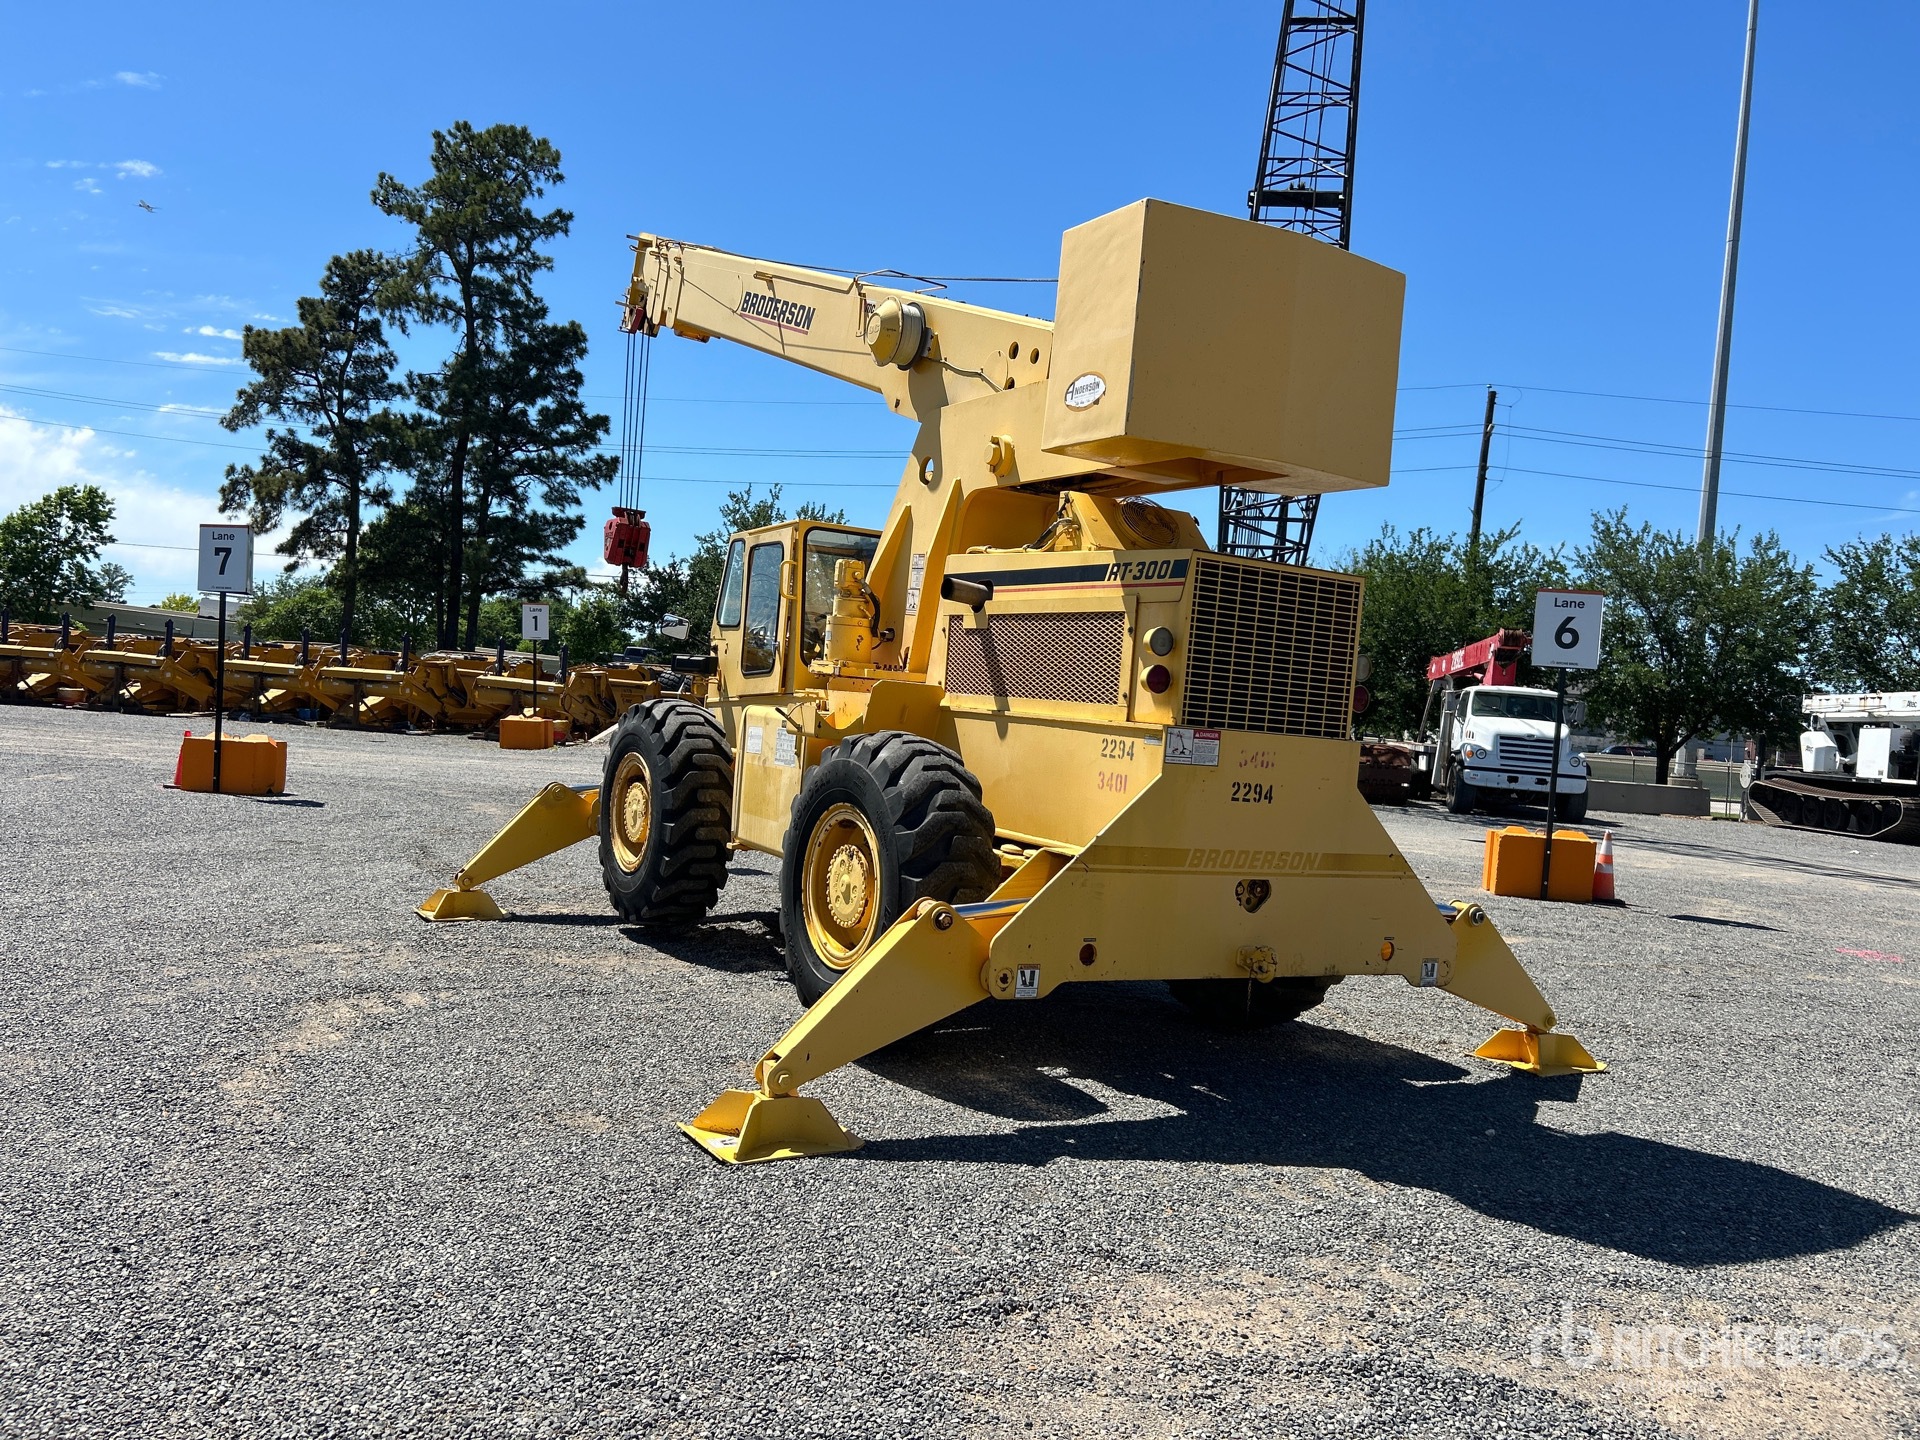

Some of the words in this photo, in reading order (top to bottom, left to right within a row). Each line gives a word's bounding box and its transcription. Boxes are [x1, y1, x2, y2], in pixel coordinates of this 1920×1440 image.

[741, 291, 816, 330] BRODERSON
[1065, 381, 1101, 401] ANDERSON
[212, 531, 235, 541] Lane
[214, 547, 232, 575] 7
[1106, 559, 1172, 581] RT-300
[1554, 597, 1586, 609] Lane
[532, 615, 538, 631] 1
[1554, 615, 1580, 650] 6
[1101, 737, 1135, 761] 2294
[1098, 771, 1128, 794] 3401
[1231, 781, 1273, 804] 2294
[1188, 848, 1319, 871] BRODERSON
